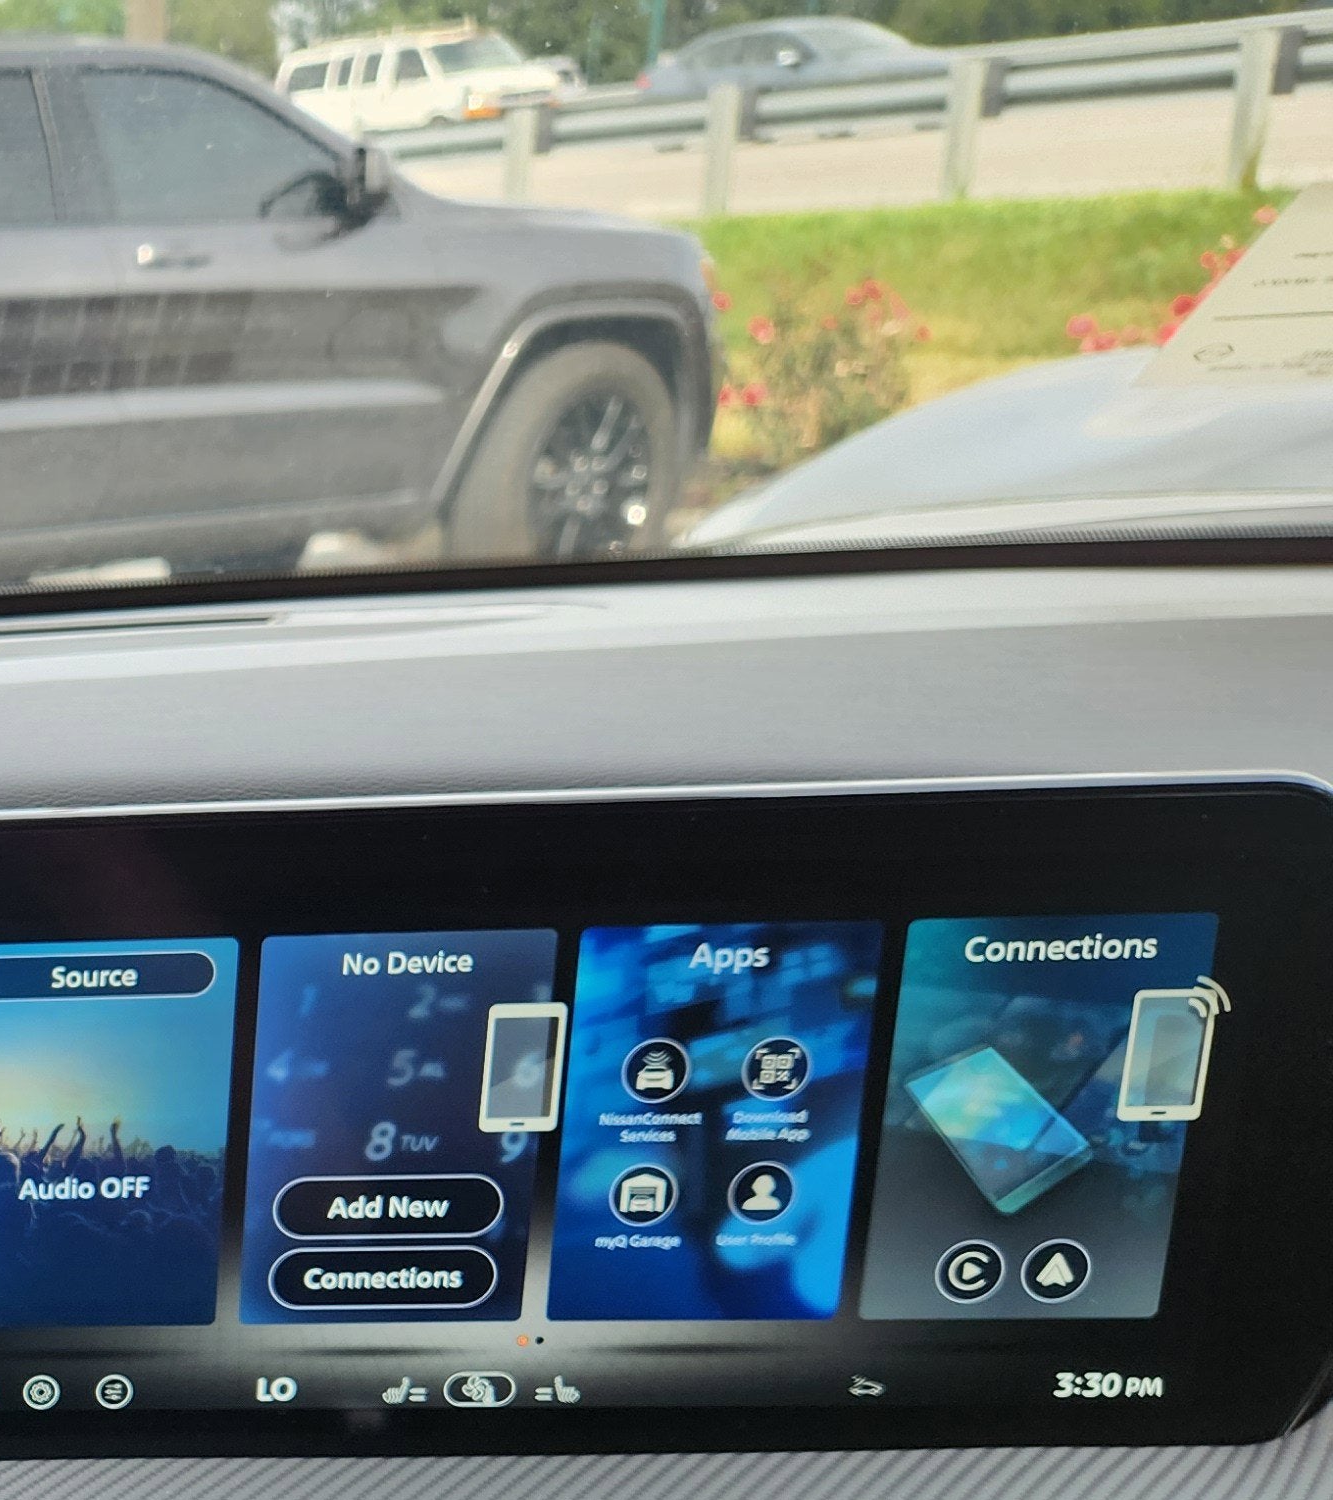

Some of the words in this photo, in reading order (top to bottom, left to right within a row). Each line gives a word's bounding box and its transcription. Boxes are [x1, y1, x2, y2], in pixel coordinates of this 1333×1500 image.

[689, 943, 771, 975] Apps
[965, 934, 1159, 964] Connections
[342, 952, 380, 976] No
[387, 950, 473, 975] Device
[50, 965, 139, 989] Source
[598, 1111, 704, 1127] NissanConnect
[732, 1108, 810, 1125] Download
[364, 1120, 397, 1162] 8
[399, 1134, 442, 1153] TUV
[618, 1128, 678, 1143] Services
[725, 1126, 778, 1142] Mobile
[778, 1127, 812, 1143] App
[17, 1175, 96, 1200] Audio
[100, 1175, 151, 1200] OFF
[326, 1195, 384, 1220] Add
[388, 1195, 451, 1219] New
[629, 1234, 681, 1251] Garage
[303, 1267, 465, 1291] Connections
[255, 1376, 298, 1402] LO
[1052, 1371, 1123, 1399] 3:30
[1125, 1376, 1164, 1398] PM
